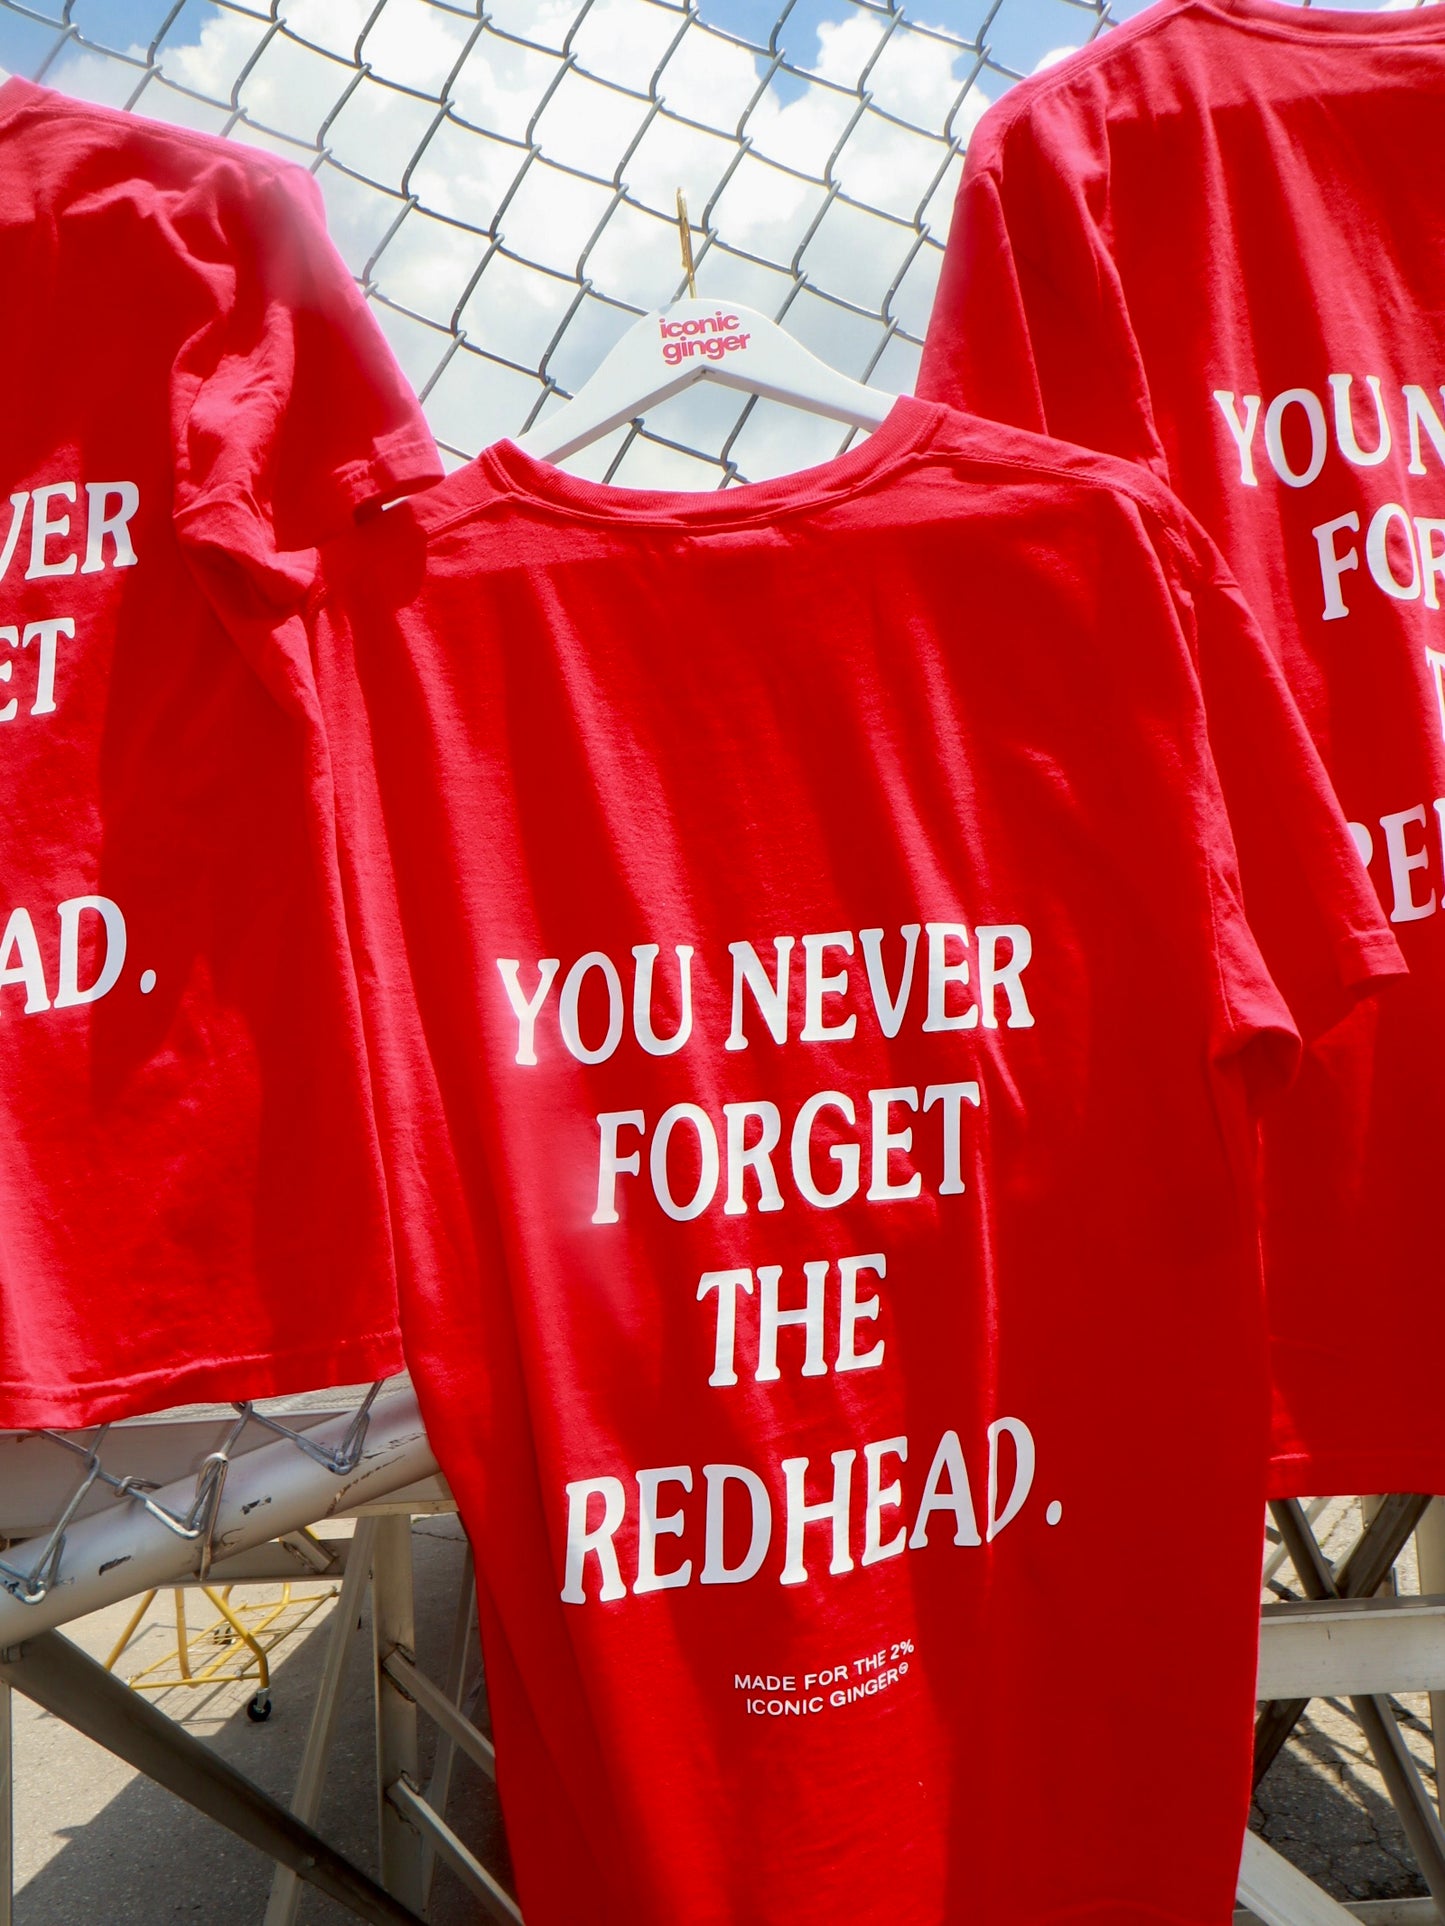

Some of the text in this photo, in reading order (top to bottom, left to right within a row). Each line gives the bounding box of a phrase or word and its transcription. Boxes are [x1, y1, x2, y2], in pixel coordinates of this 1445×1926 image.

[659, 311, 740, 338] iconic
[662, 333, 751, 365] ginger
[1213, 373, 1392, 488] YOU
[495, 922, 1036, 1066] YOU NEVER
[591, 1081, 981, 1225] FORGET
[696, 1253, 887, 1387] THE
[560, 1416, 1062, 1605] REDHEAD.
[734, 1639, 915, 1691] MADE FOR THE 2%
[747, 1697, 824, 1715] ICONIC
